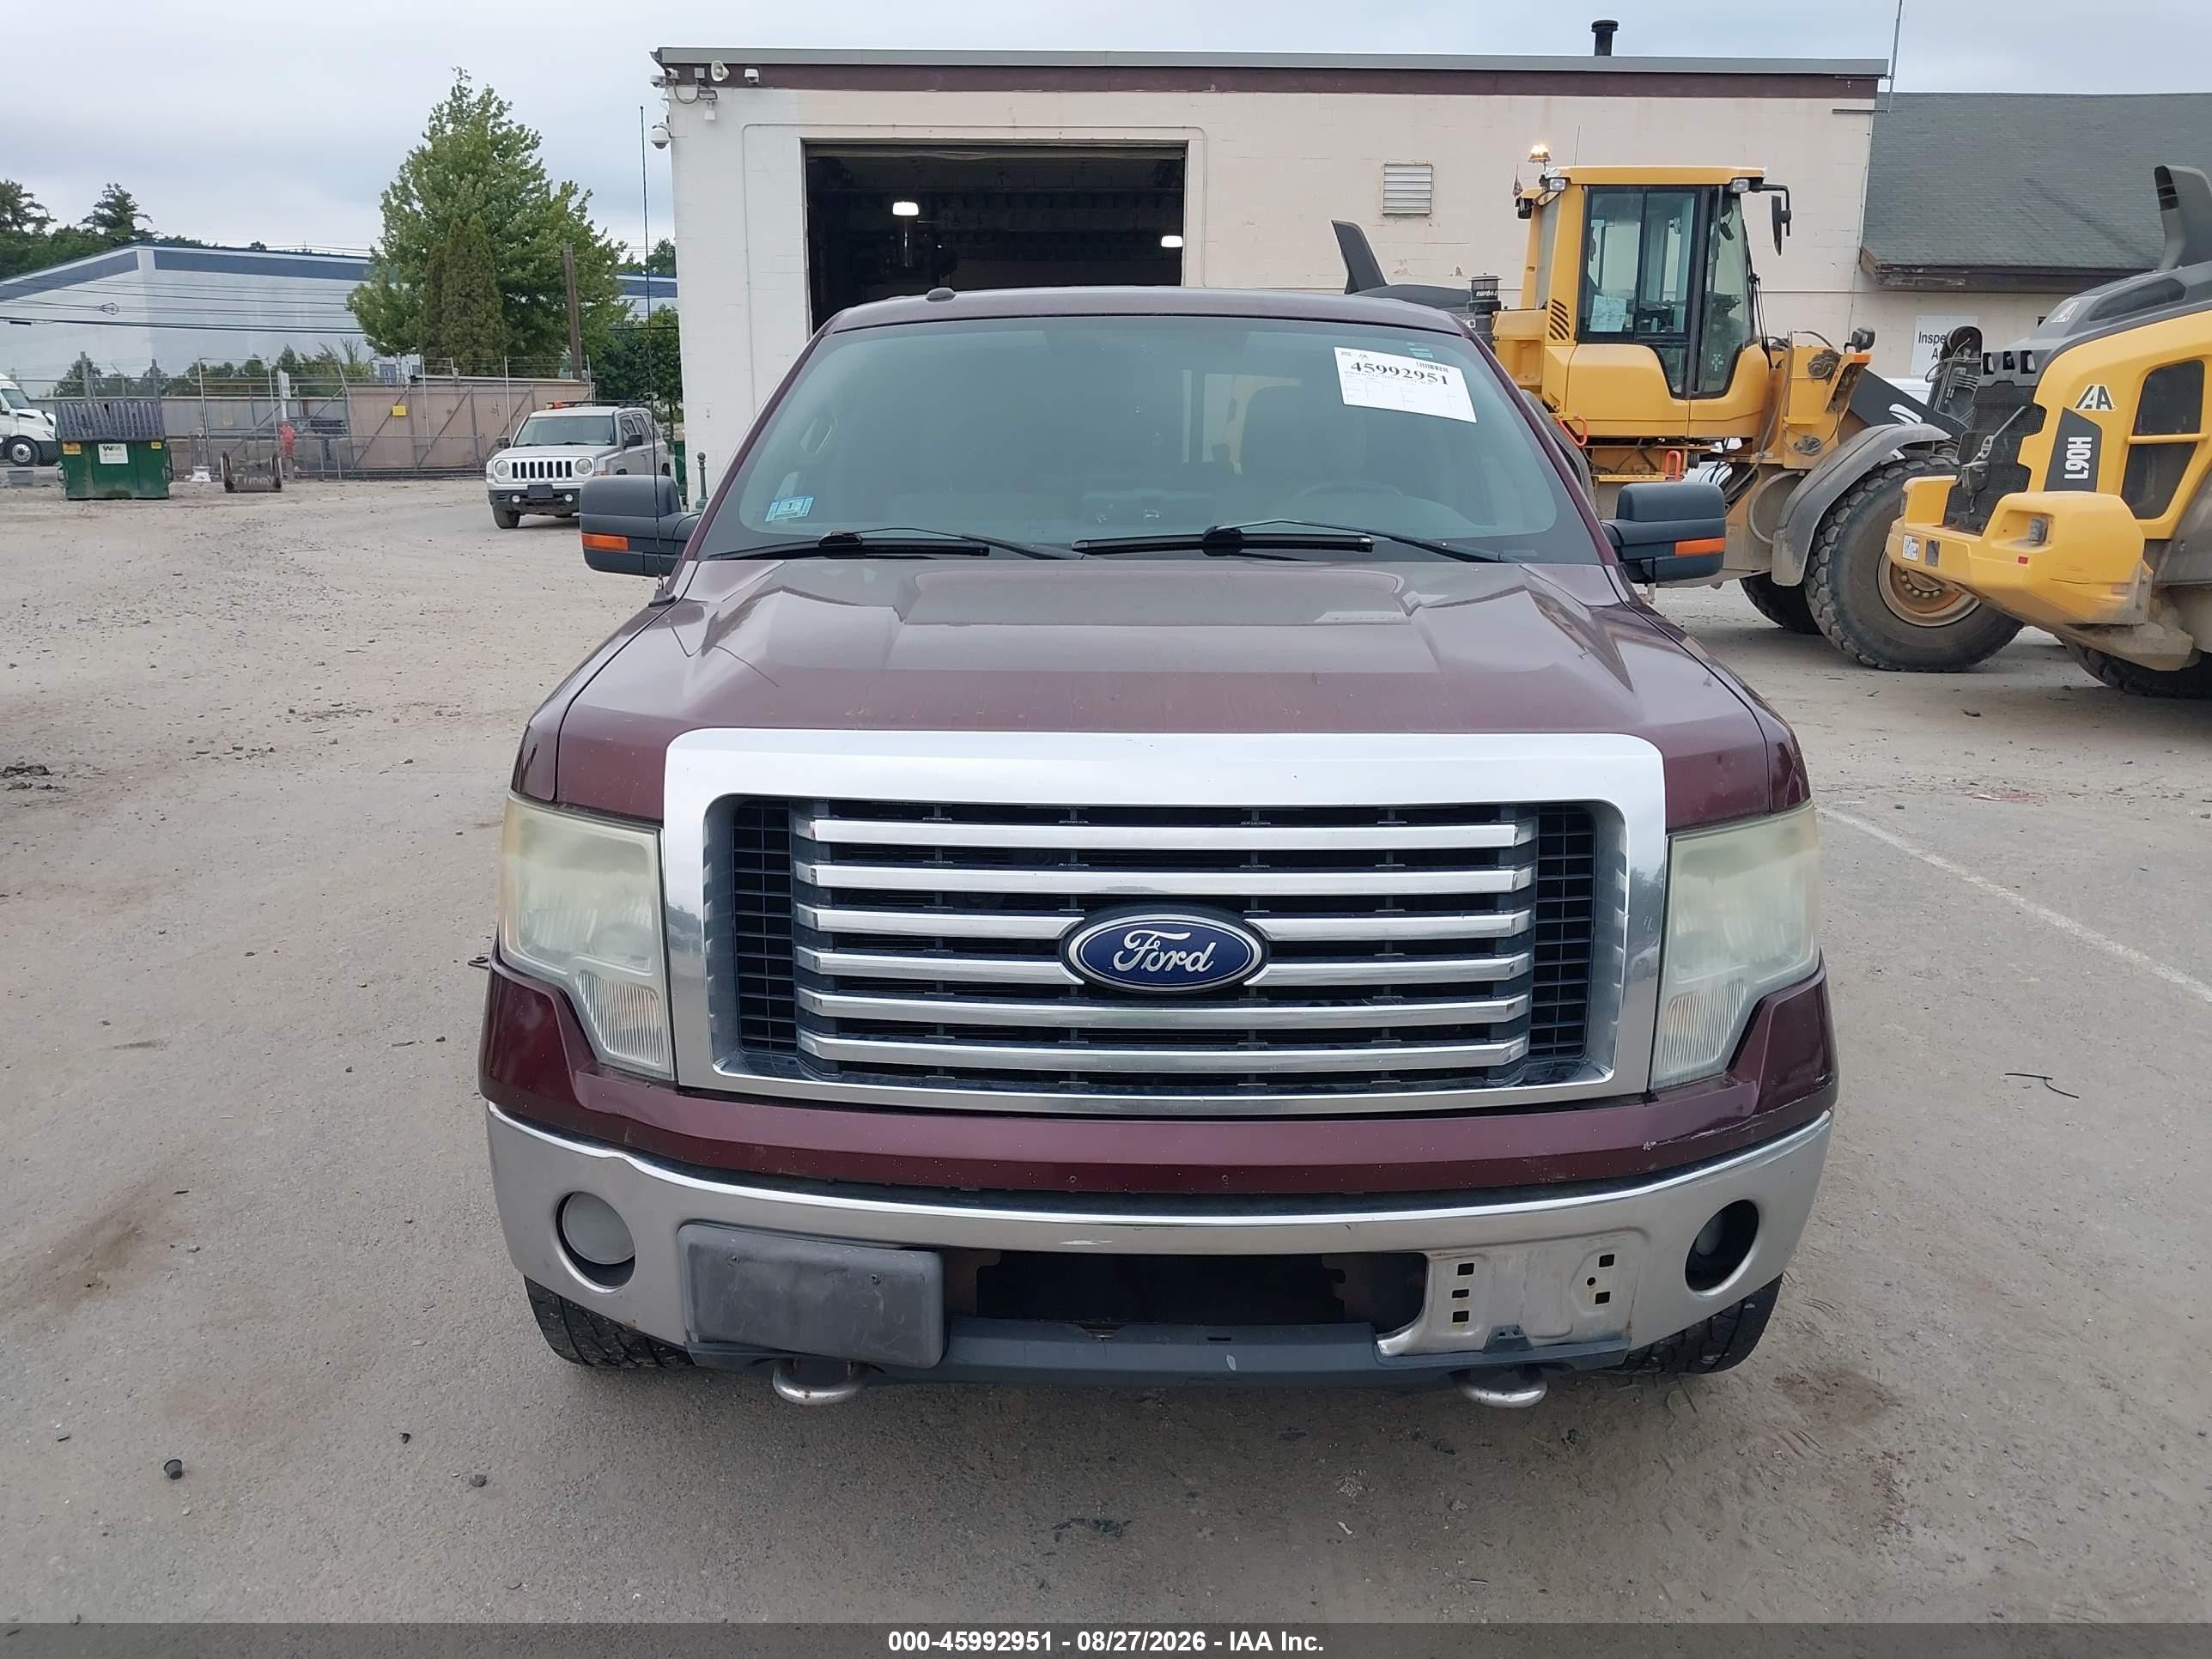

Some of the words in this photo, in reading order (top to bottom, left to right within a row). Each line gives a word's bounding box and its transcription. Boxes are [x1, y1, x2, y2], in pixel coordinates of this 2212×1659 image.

[1917, 331, 1947, 346] Inspe
[1351, 362, 1448, 386] 45992951
[2063, 436, 2093, 479] L90H
[1113, 929, 1217, 972] Ford
